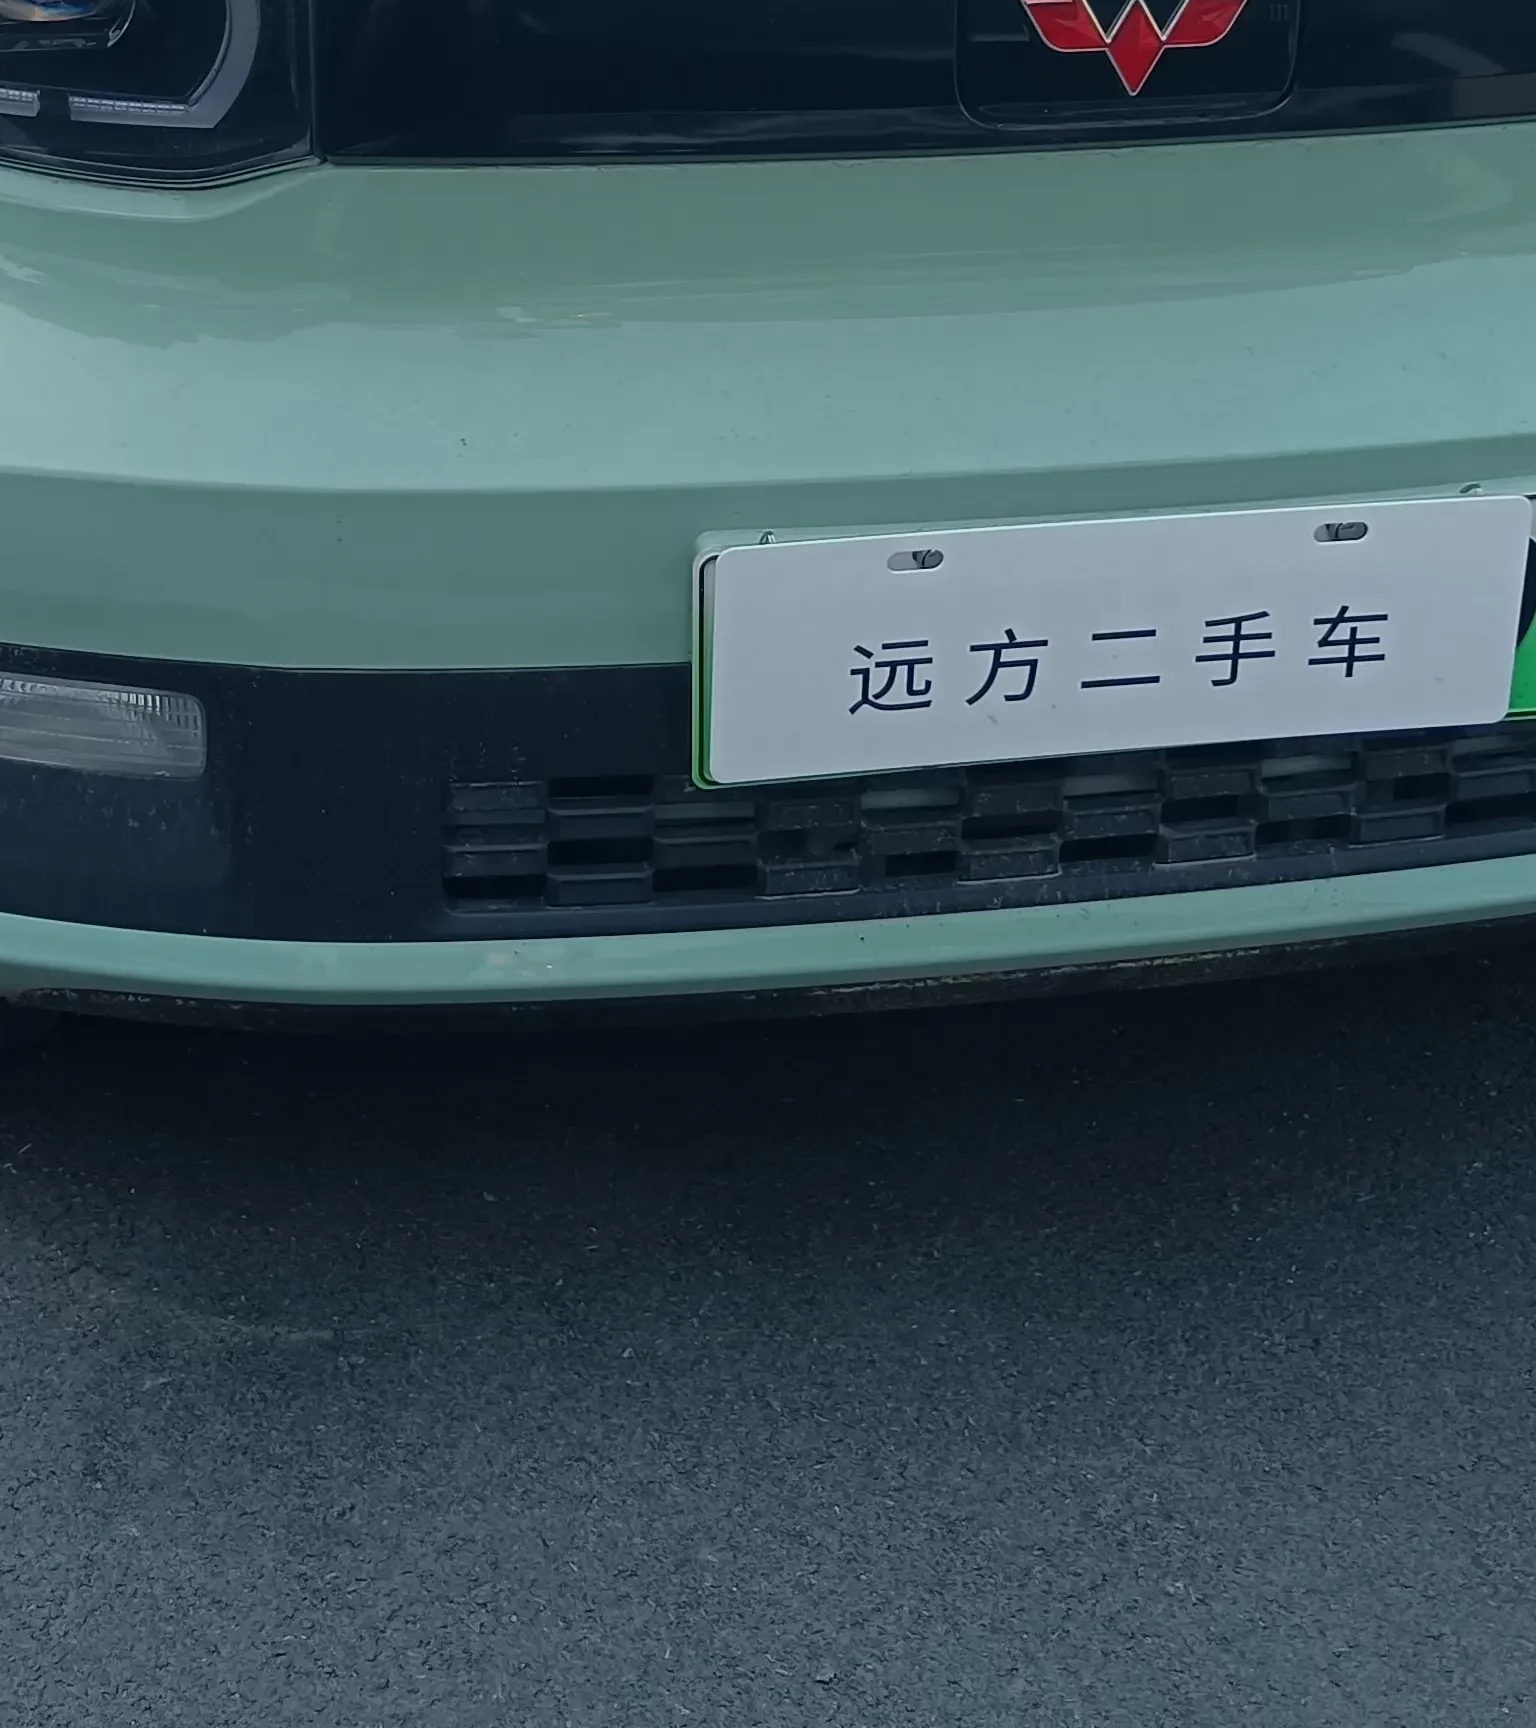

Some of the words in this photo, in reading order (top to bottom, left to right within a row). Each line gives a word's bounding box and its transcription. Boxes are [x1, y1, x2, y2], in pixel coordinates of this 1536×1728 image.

[847, 603, 1390, 717] 远方二手车
